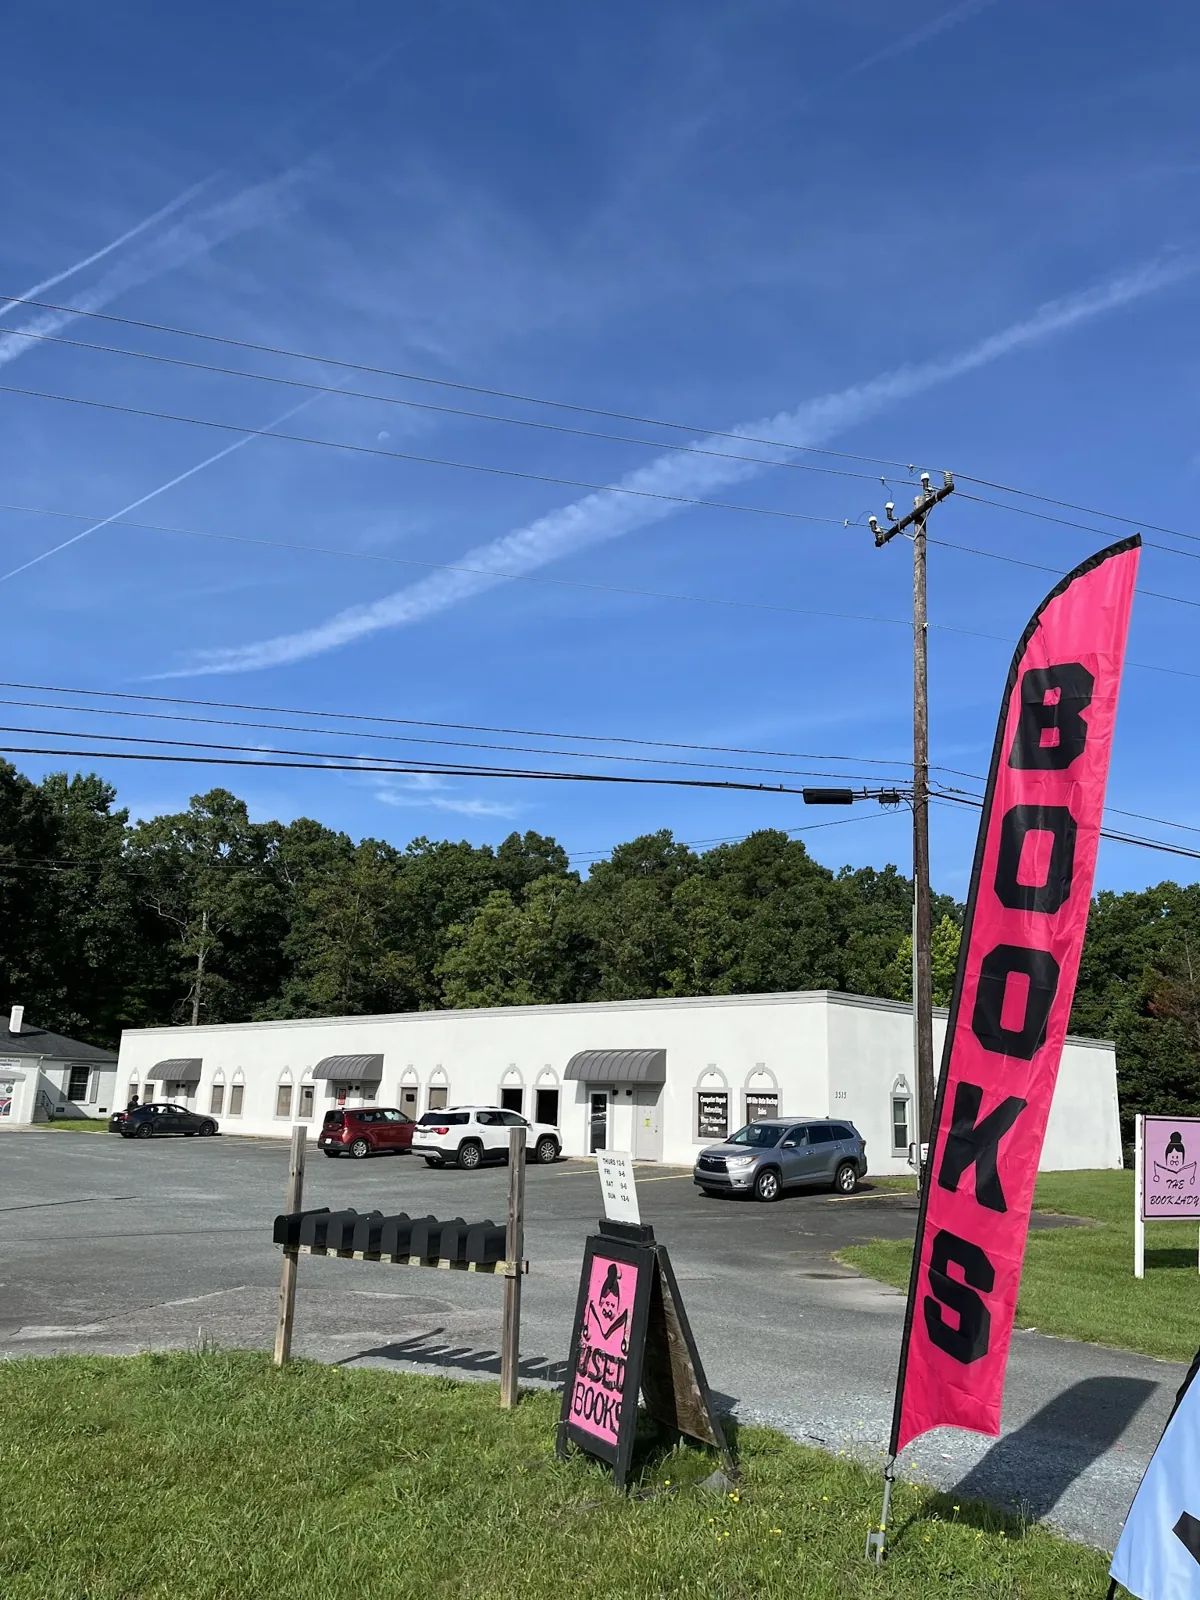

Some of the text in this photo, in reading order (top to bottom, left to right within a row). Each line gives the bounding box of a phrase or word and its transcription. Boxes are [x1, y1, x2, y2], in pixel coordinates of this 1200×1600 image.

[924, 662, 1095, 1366] BOOKS
[603, 1158, 616, 1166] THURS
[1166, 1179, 1185, 1190] THE
[576, 1345, 626, 1394] USED
[573, 1381, 621, 1436] BOOKS
